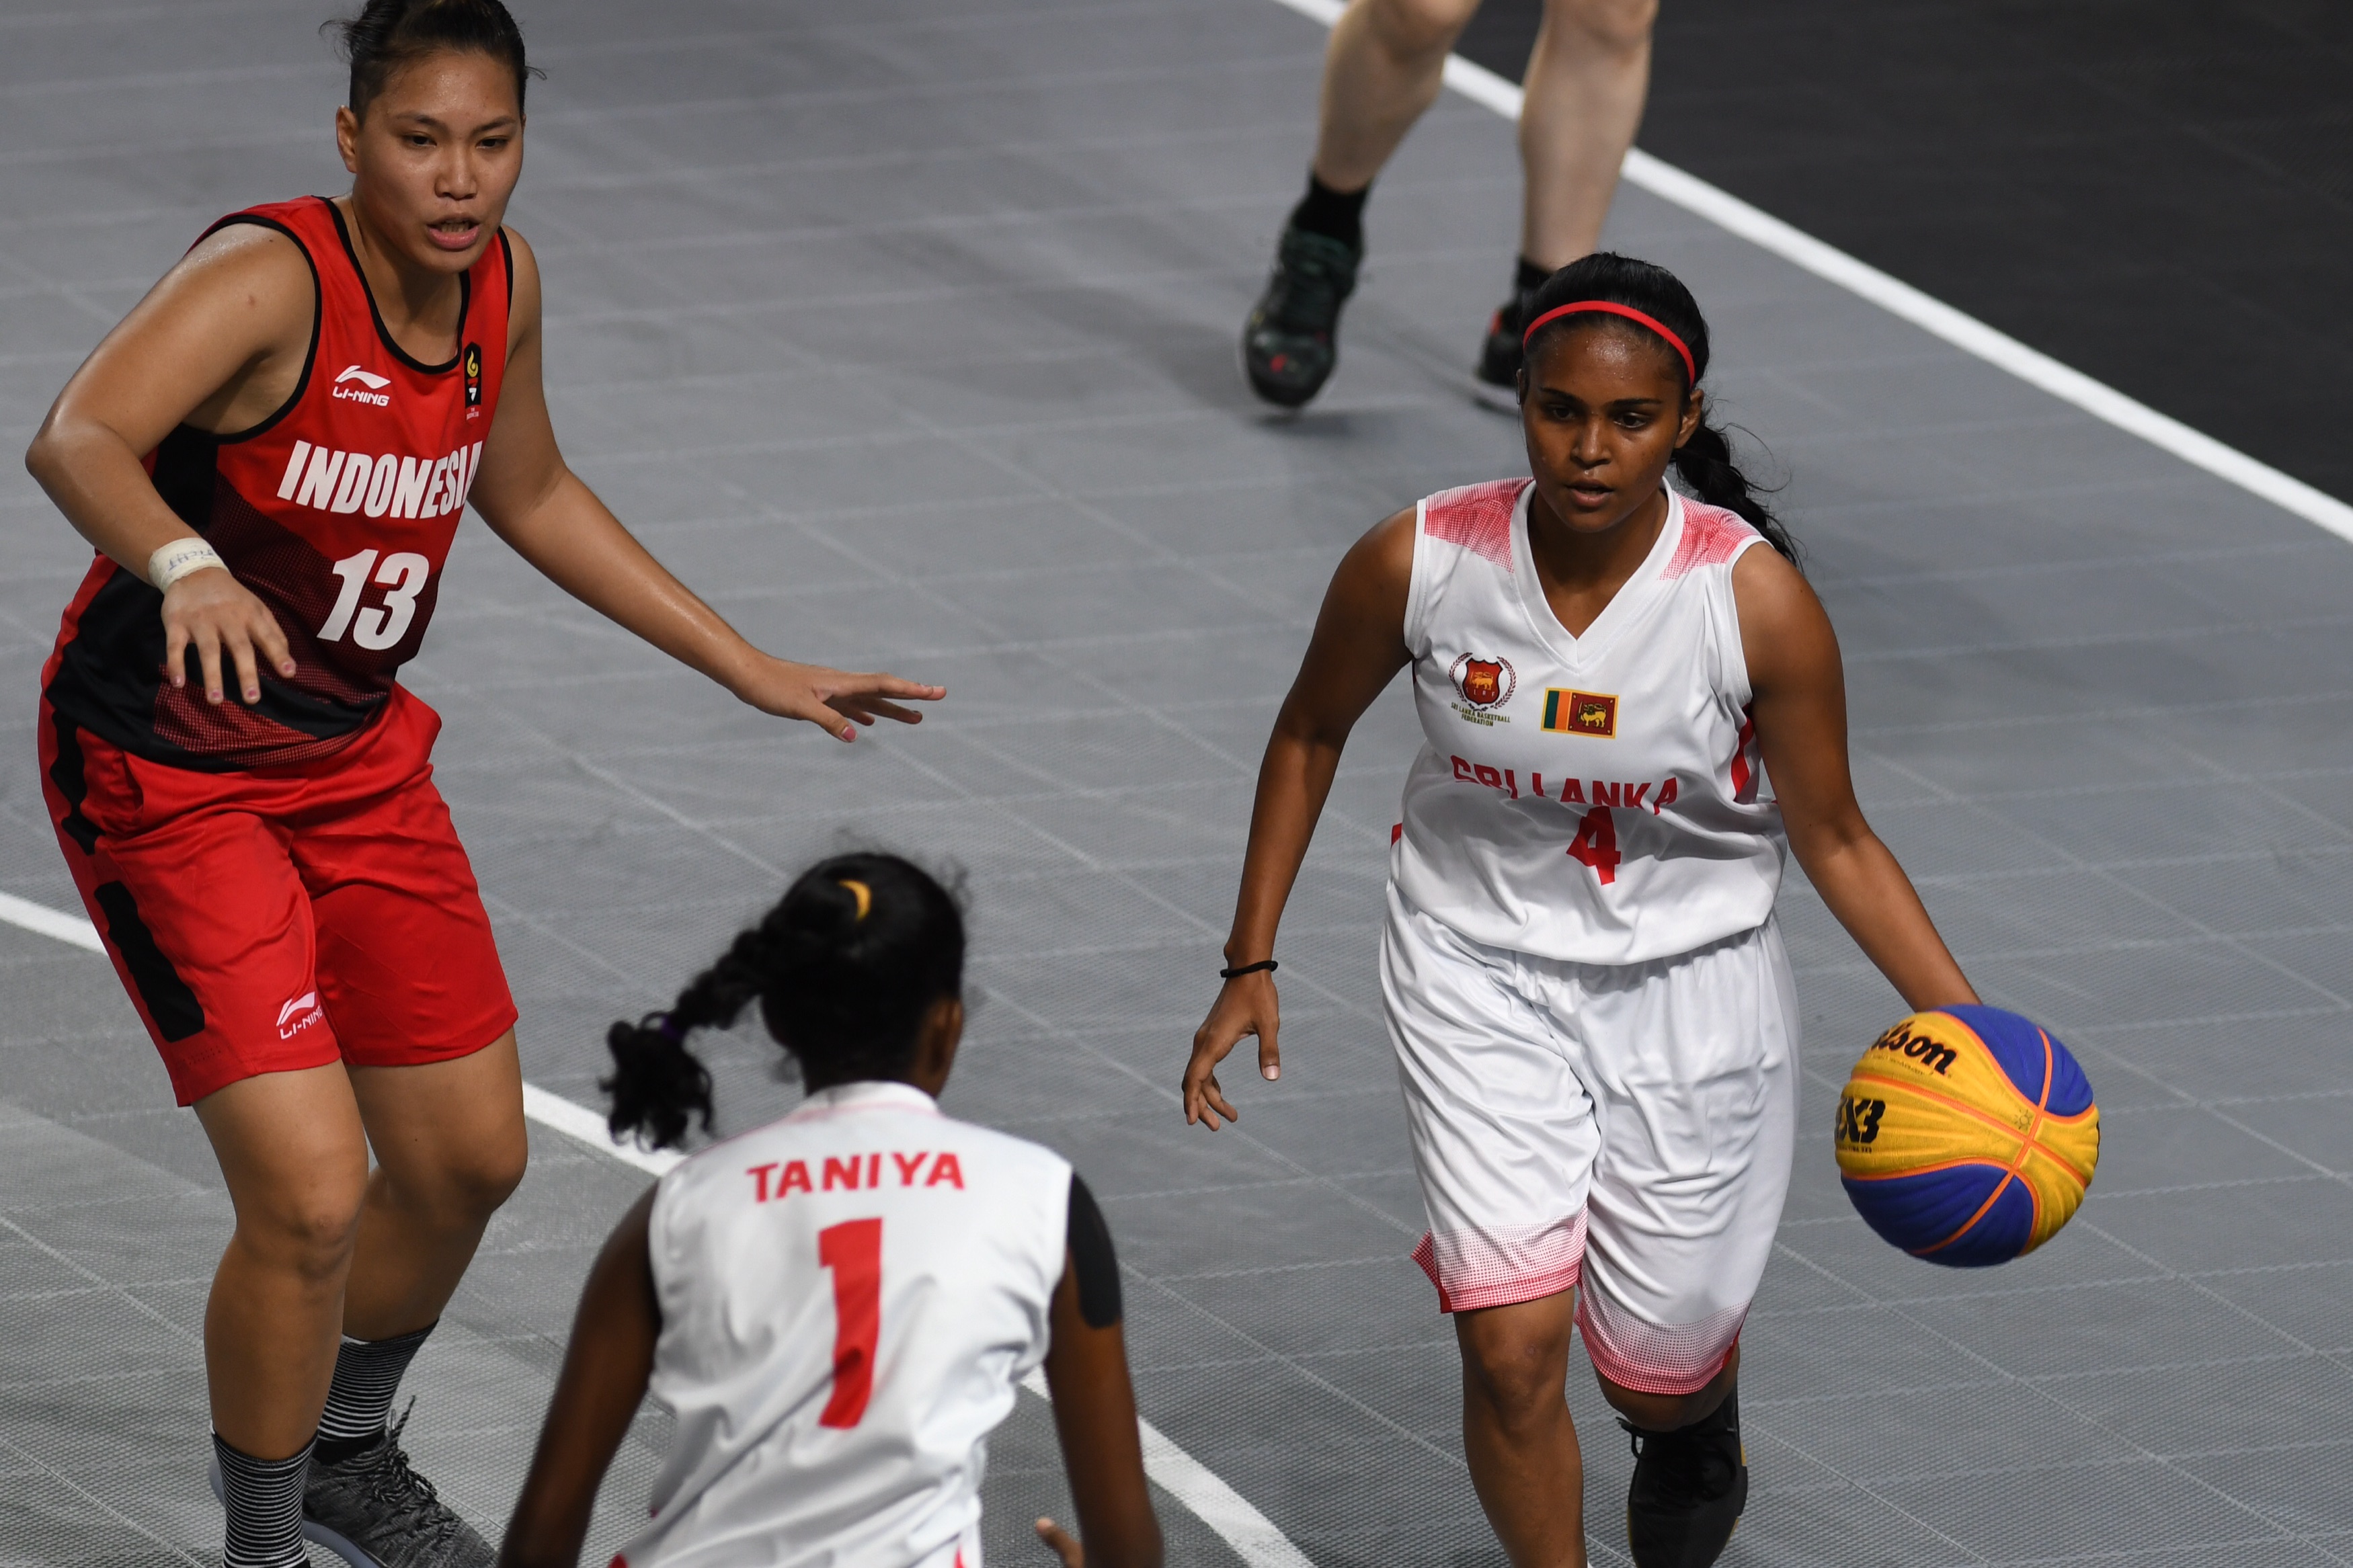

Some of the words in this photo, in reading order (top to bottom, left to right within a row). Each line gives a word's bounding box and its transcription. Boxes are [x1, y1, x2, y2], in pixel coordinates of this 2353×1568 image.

[332, 386, 390, 407] LI-NING
[317, 548, 430, 650] 13
[1462, 714, 1494, 727] FEDERATION
[1477, 711, 1511, 723] BASKETBALL
[1566, 806, 1622, 886] 4
[280, 1005, 323, 1040] LI-NING
[746, 1151, 965, 1203] TANIYA
[818, 1217, 883, 1430] 1
